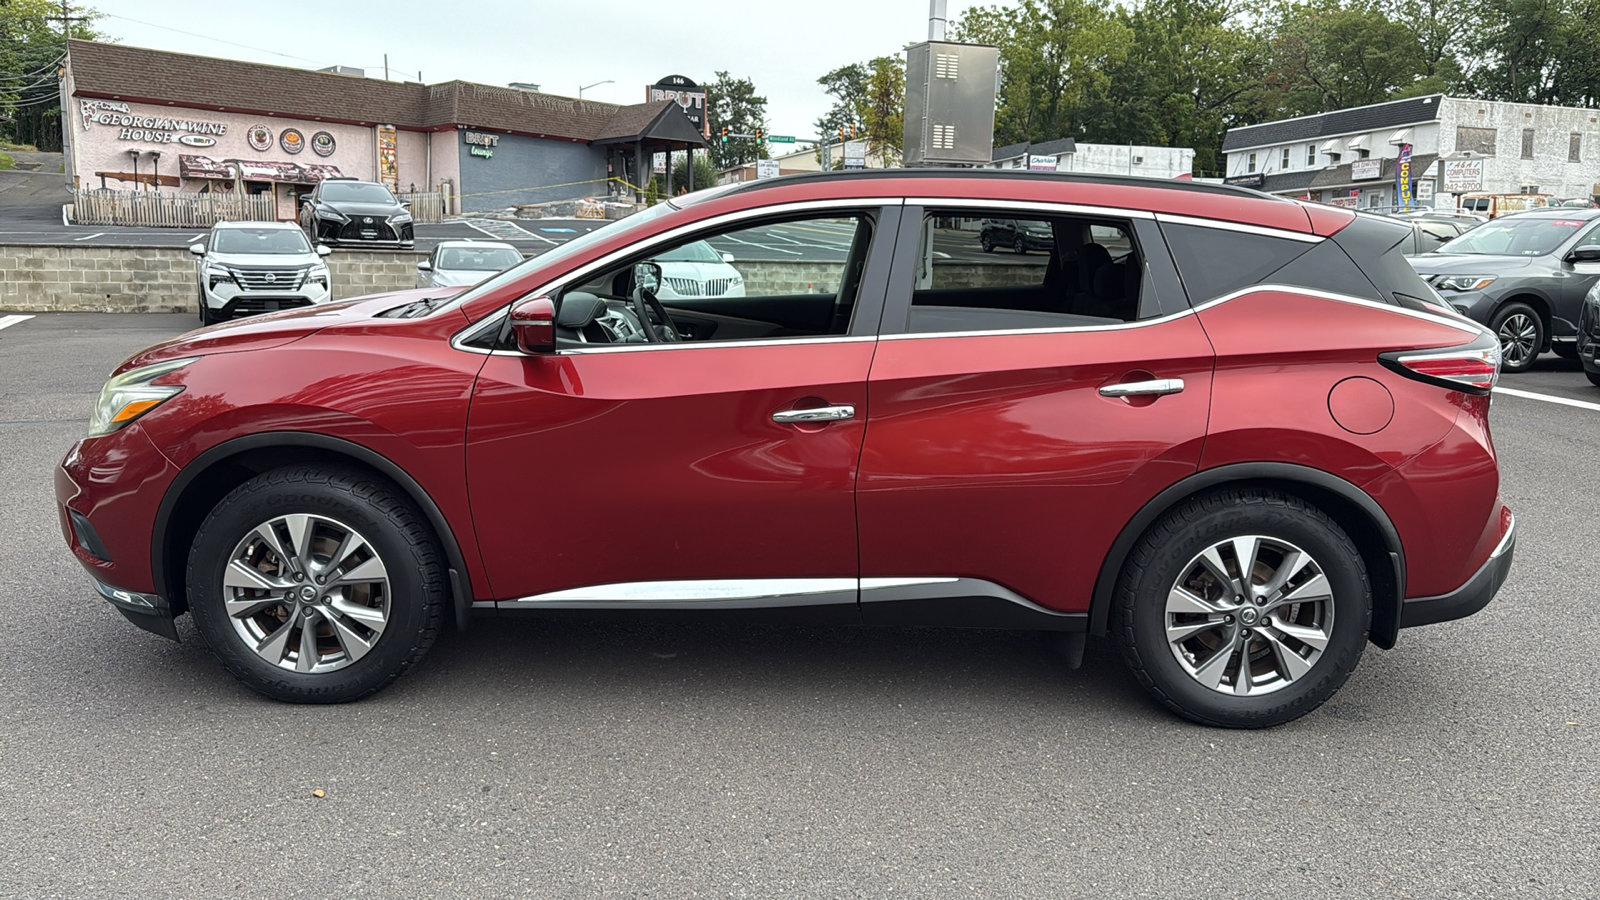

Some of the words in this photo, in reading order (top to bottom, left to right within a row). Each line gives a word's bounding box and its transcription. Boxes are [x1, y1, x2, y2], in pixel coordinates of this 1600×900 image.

[651, 88, 705, 109] BRUT
[99, 113, 183, 131] GEORGIAN
[187, 122, 229, 135] WINE
[119, 128, 172, 144] HOUSE
[465, 131, 499, 147] BRUT
[1446, 168, 1481, 176] COMPUTERS
[1444, 182, 1481, 191] 942-9700
